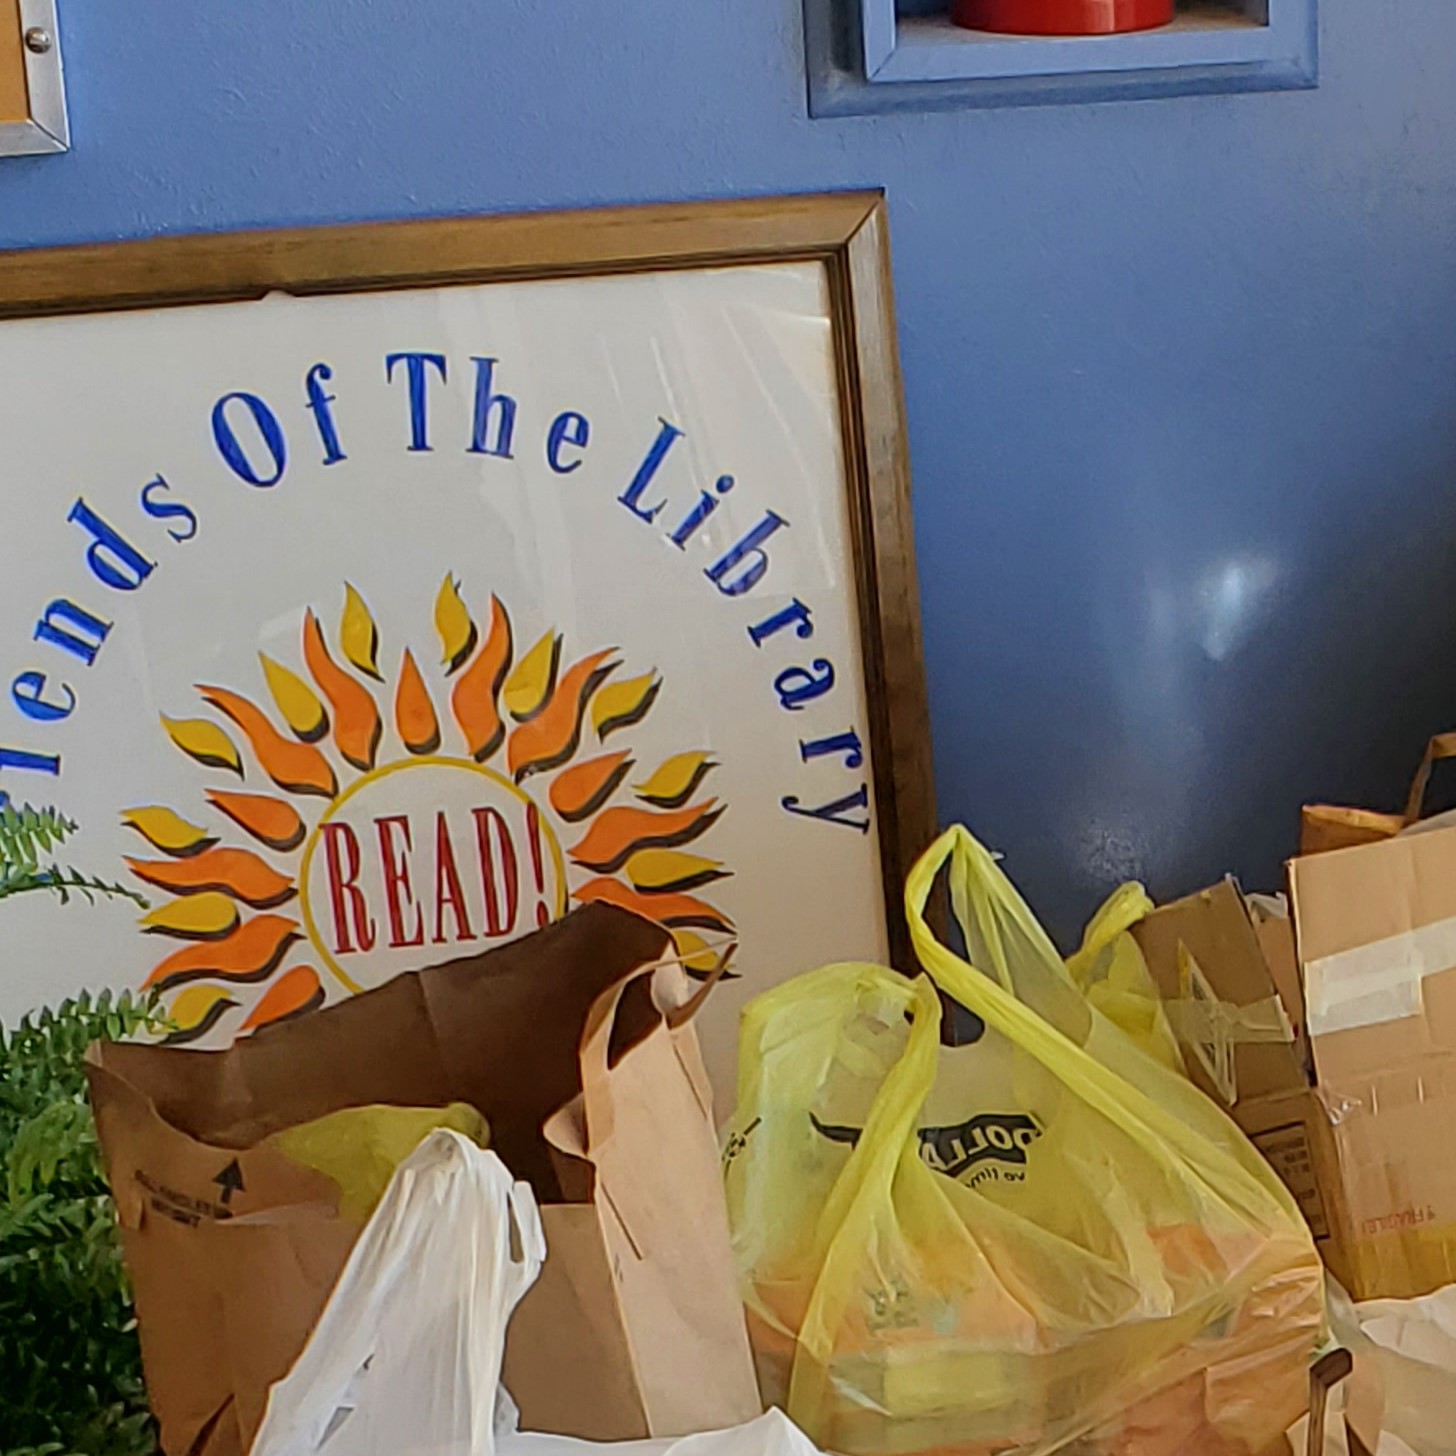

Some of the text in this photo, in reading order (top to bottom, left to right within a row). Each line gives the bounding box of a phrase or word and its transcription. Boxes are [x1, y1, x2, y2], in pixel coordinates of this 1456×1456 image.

[0, 351, 870, 836] iends Of The Library
[318, 802, 549, 955] READ!
